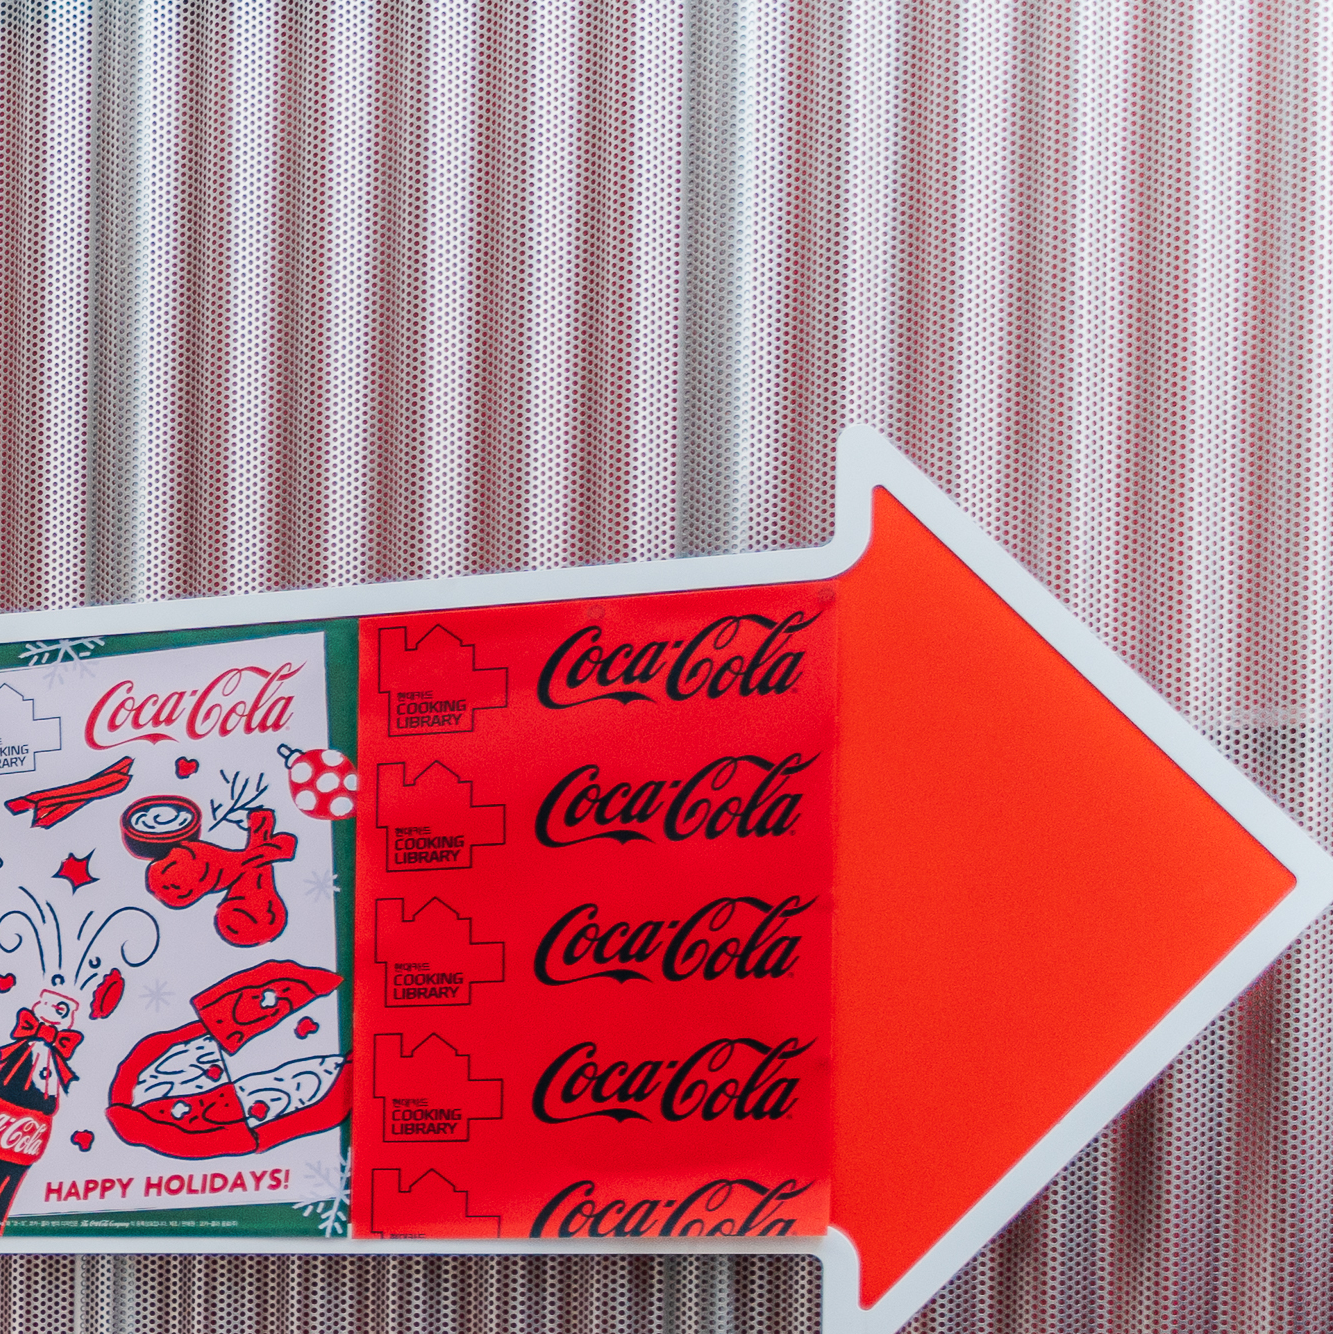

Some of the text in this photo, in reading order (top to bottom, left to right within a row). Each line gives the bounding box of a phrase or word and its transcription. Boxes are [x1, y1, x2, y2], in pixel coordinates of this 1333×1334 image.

[536, 610, 823, 710] Coca-Cola
[84, 661, 307, 751] Coca-Cola
[397, 699, 466, 715] COOKING
[397, 713, 462, 729] LIBRARY
[534, 751, 822, 848] Coca-Cola
[394, 835, 464, 851] COOKING
[394, 849, 460, 864] LIBRARY
[534, 895, 820, 987] Coca-Cola
[394, 972, 463, 986] COOKING
[394, 986, 459, 1000] LIBRARY
[532, 1036, 818, 1124] Coca-Cola
[392, 1108, 462, 1122] COOKING
[392, 1122, 458, 1135] LIBRARY
[44, 1168, 290, 1202] HAPPY HOLIDAYS!
